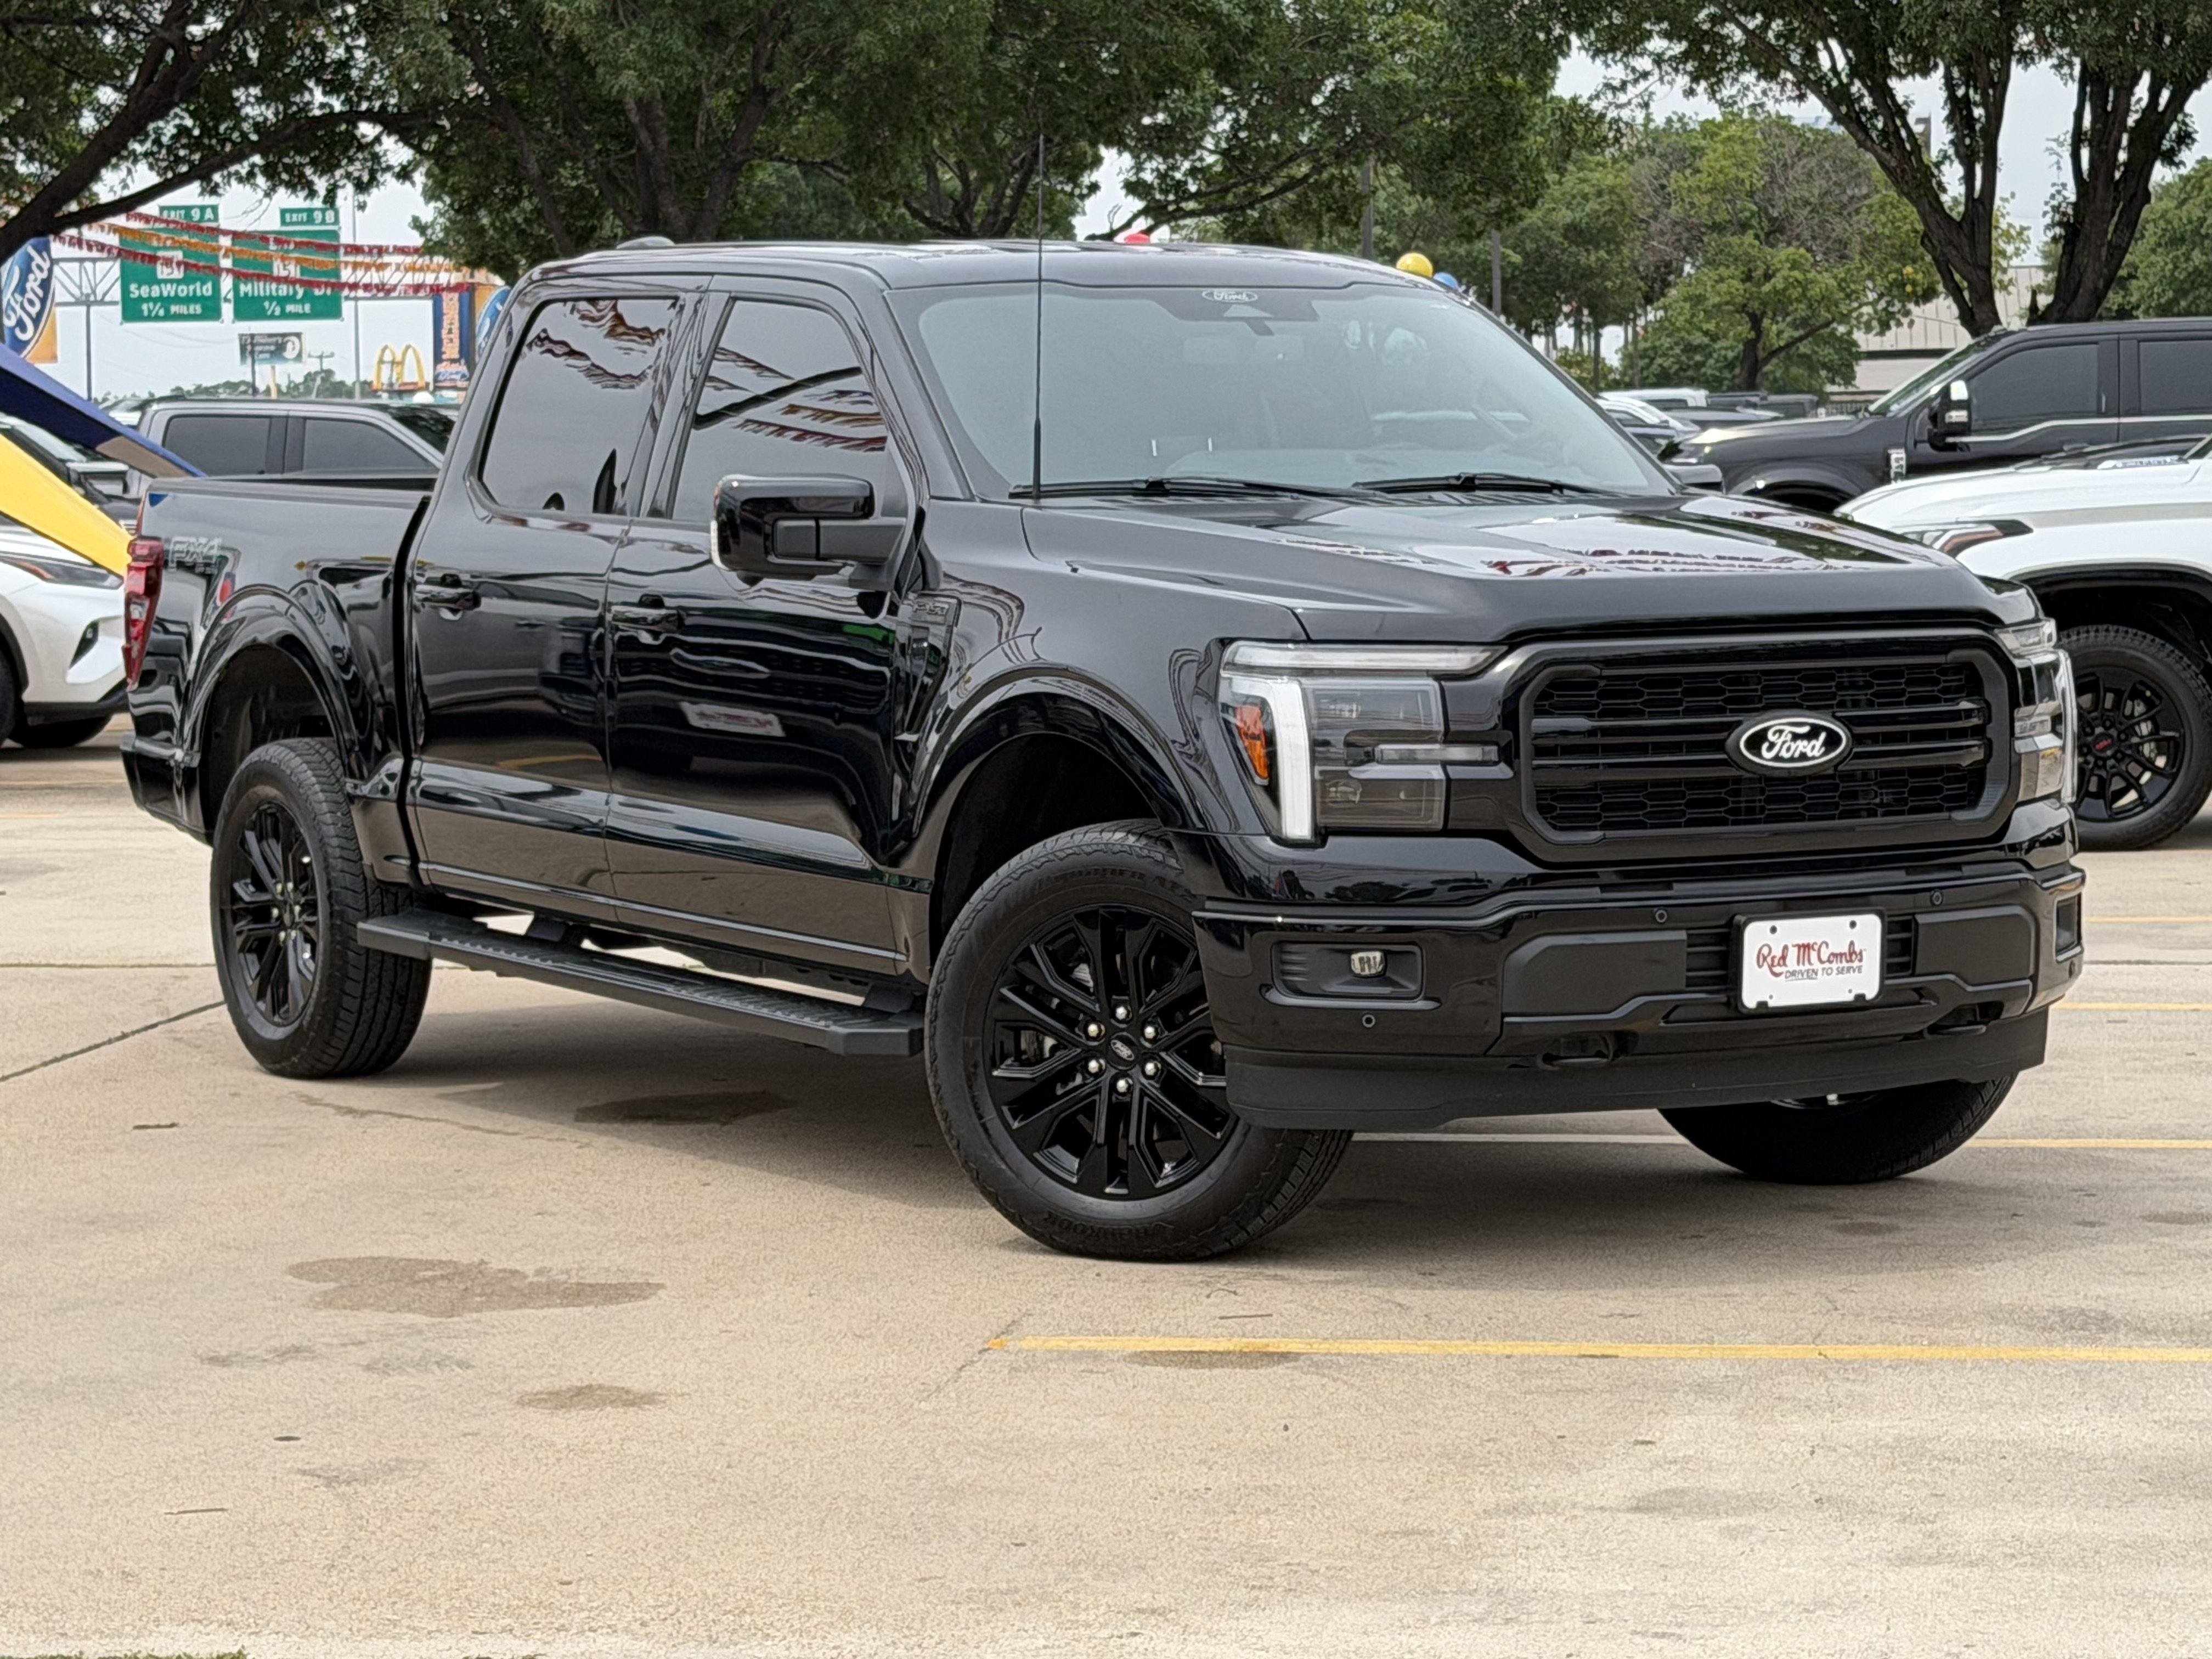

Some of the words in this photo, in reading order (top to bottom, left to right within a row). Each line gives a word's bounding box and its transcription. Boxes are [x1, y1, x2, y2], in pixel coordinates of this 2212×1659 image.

[285, 212, 308, 222] EXIT
[2, 244, 50, 341] Ford
[129, 280, 213, 298] SeaWorld
[239, 281, 304, 300] Military
[170, 303, 202, 315] MILES
[285, 303, 311, 313] MILE
[1761, 725, 1827, 759] Ford
[1756, 943, 1789, 978] Red
[1792, 939, 1864, 967] McCombs
[1784, 968, 1818, 980] DRIVEN
[1821, 967, 1833, 977] TO
[1835, 965, 1863, 976] SERVE
